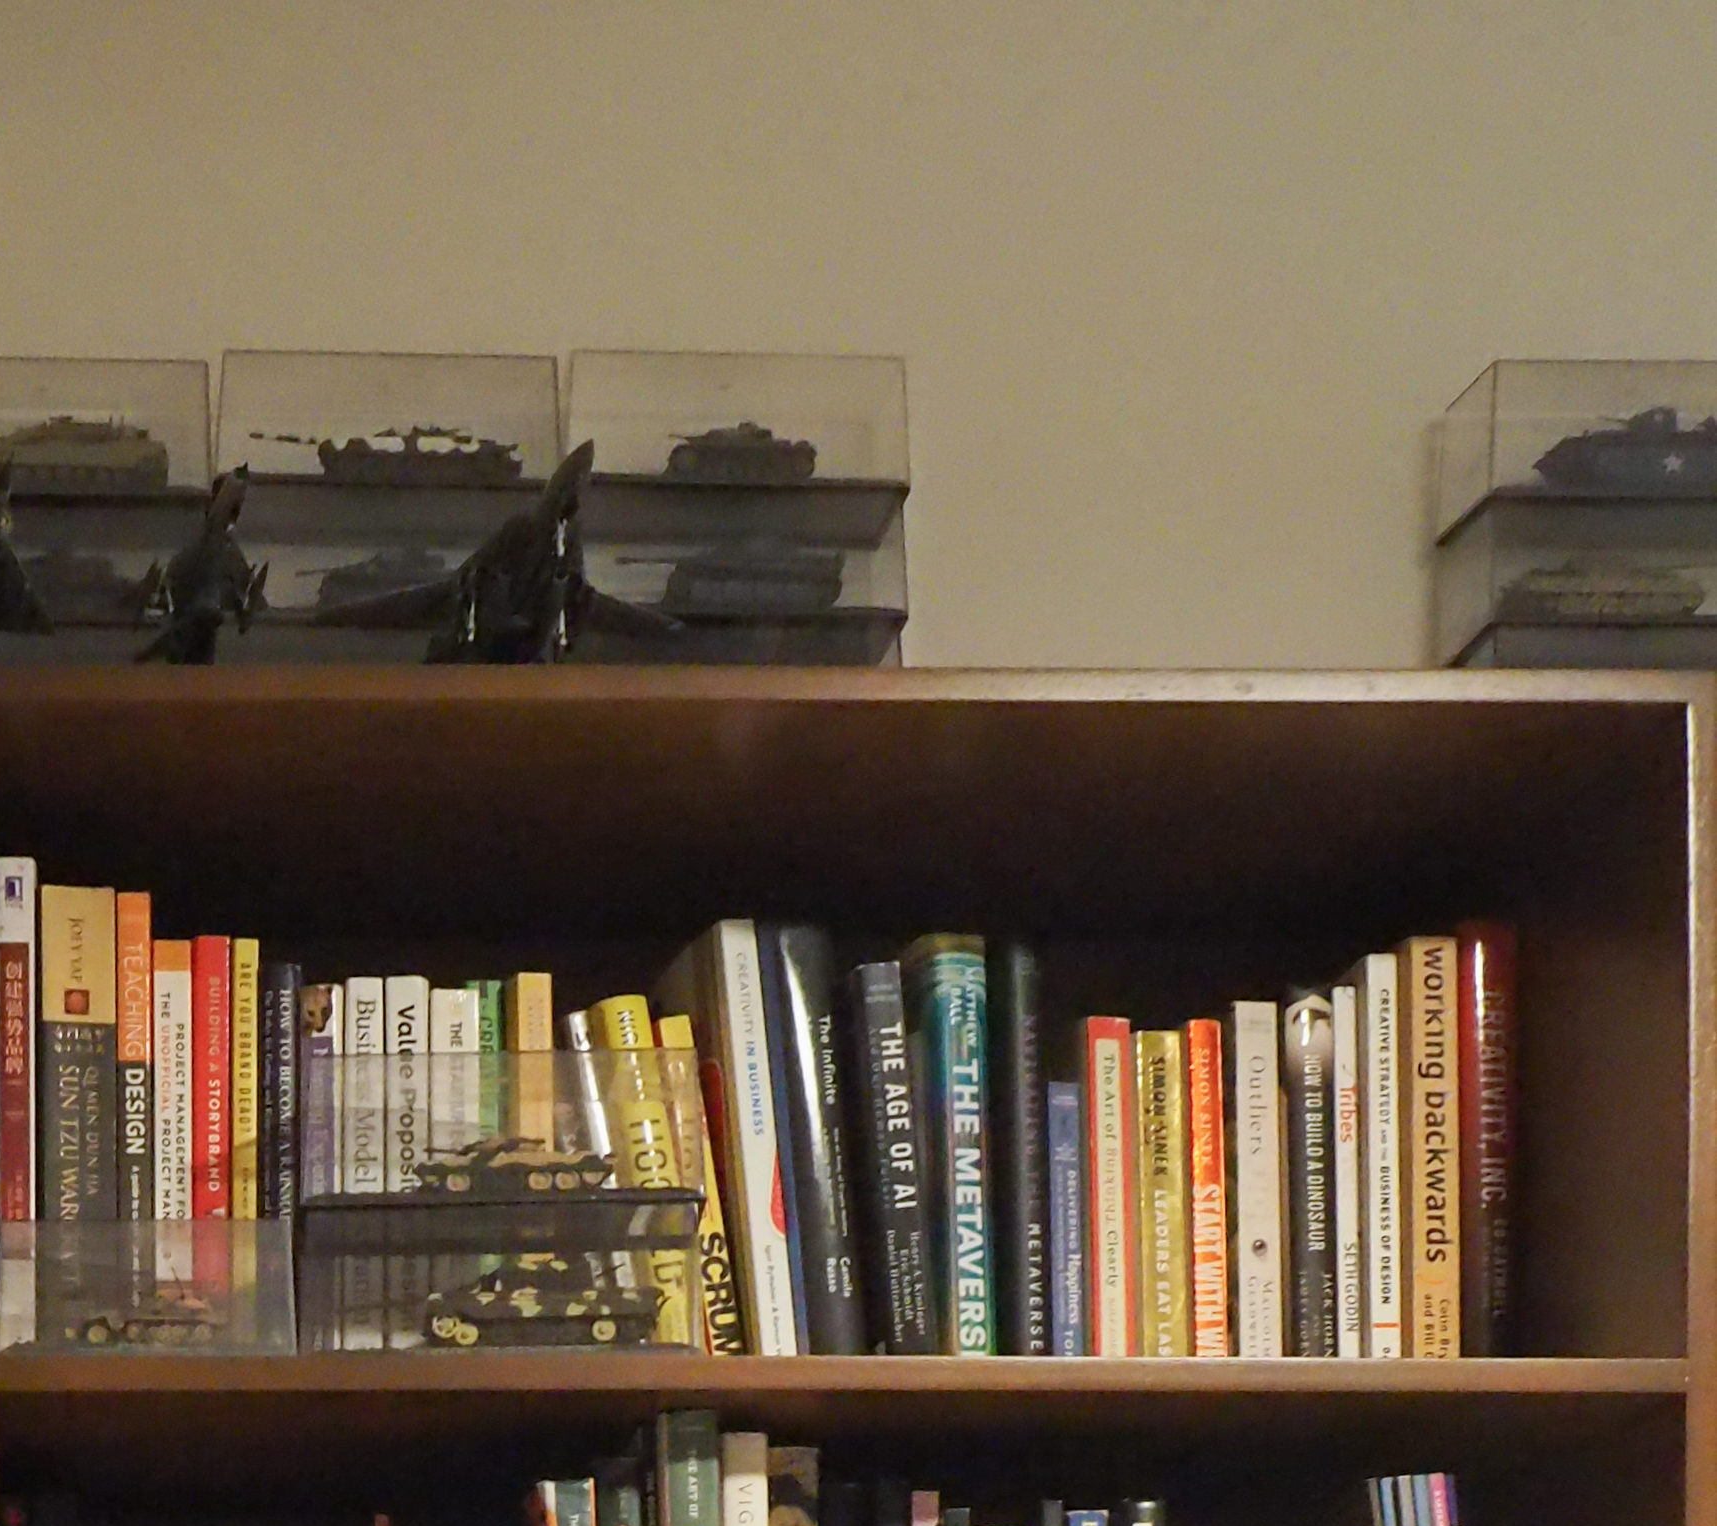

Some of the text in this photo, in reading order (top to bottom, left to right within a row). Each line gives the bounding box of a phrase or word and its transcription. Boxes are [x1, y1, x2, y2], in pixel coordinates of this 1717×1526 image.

[124, 942, 145, 1154] TEACHING DESIGN
[819, 1014, 837, 1104] The Infinite
[880, 1023, 917, 1209] THE AGE OF AI
[1248, 1056, 1266, 1155] Outliers
[1340, 1085, 1356, 1143] Tribes
[1419, 948, 1450, 1263] working backwards
[951, 1059, 986, 1356] THE METAVERS
